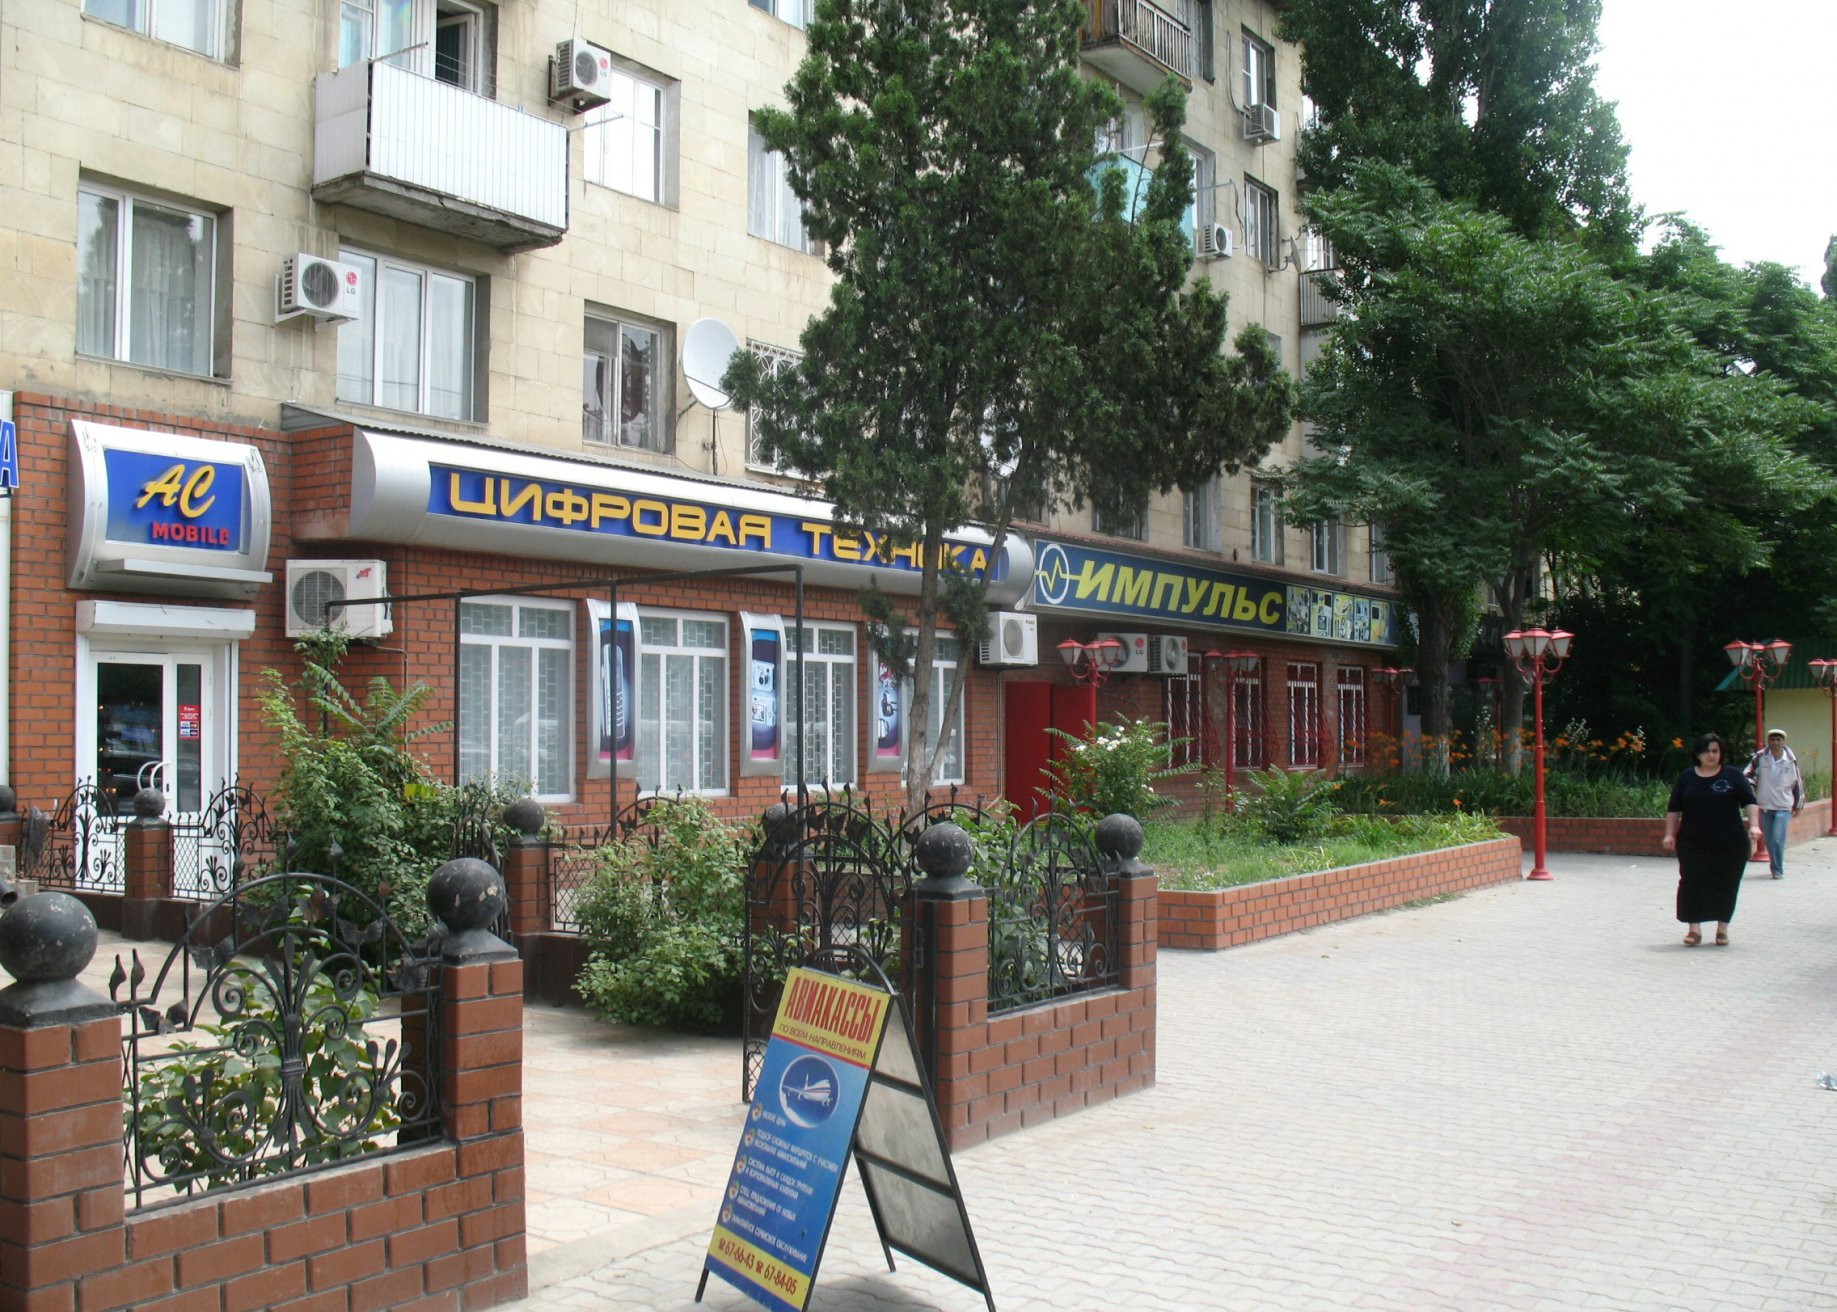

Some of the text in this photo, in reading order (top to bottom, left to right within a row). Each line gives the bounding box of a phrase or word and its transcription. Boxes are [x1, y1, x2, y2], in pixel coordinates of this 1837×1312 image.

[346, 287, 356, 295] LG
[136, 464, 215, 518] AC
[450, 472, 772, 549] ЦИФРОВАЯ
[152, 521, 229, 545] MOBILE
[1075, 560, 1283, 625] ИМПУЛЬС
[784, 976, 881, 1044] АВИАКАССЫ
[779, 1023, 867, 1059] ПО ВСЕМ НАПРАВЛЕНИЯМ
[724, 1239, 755, 1270] 67-66-43
[763, 1263, 798, 1296] 67-84-05
